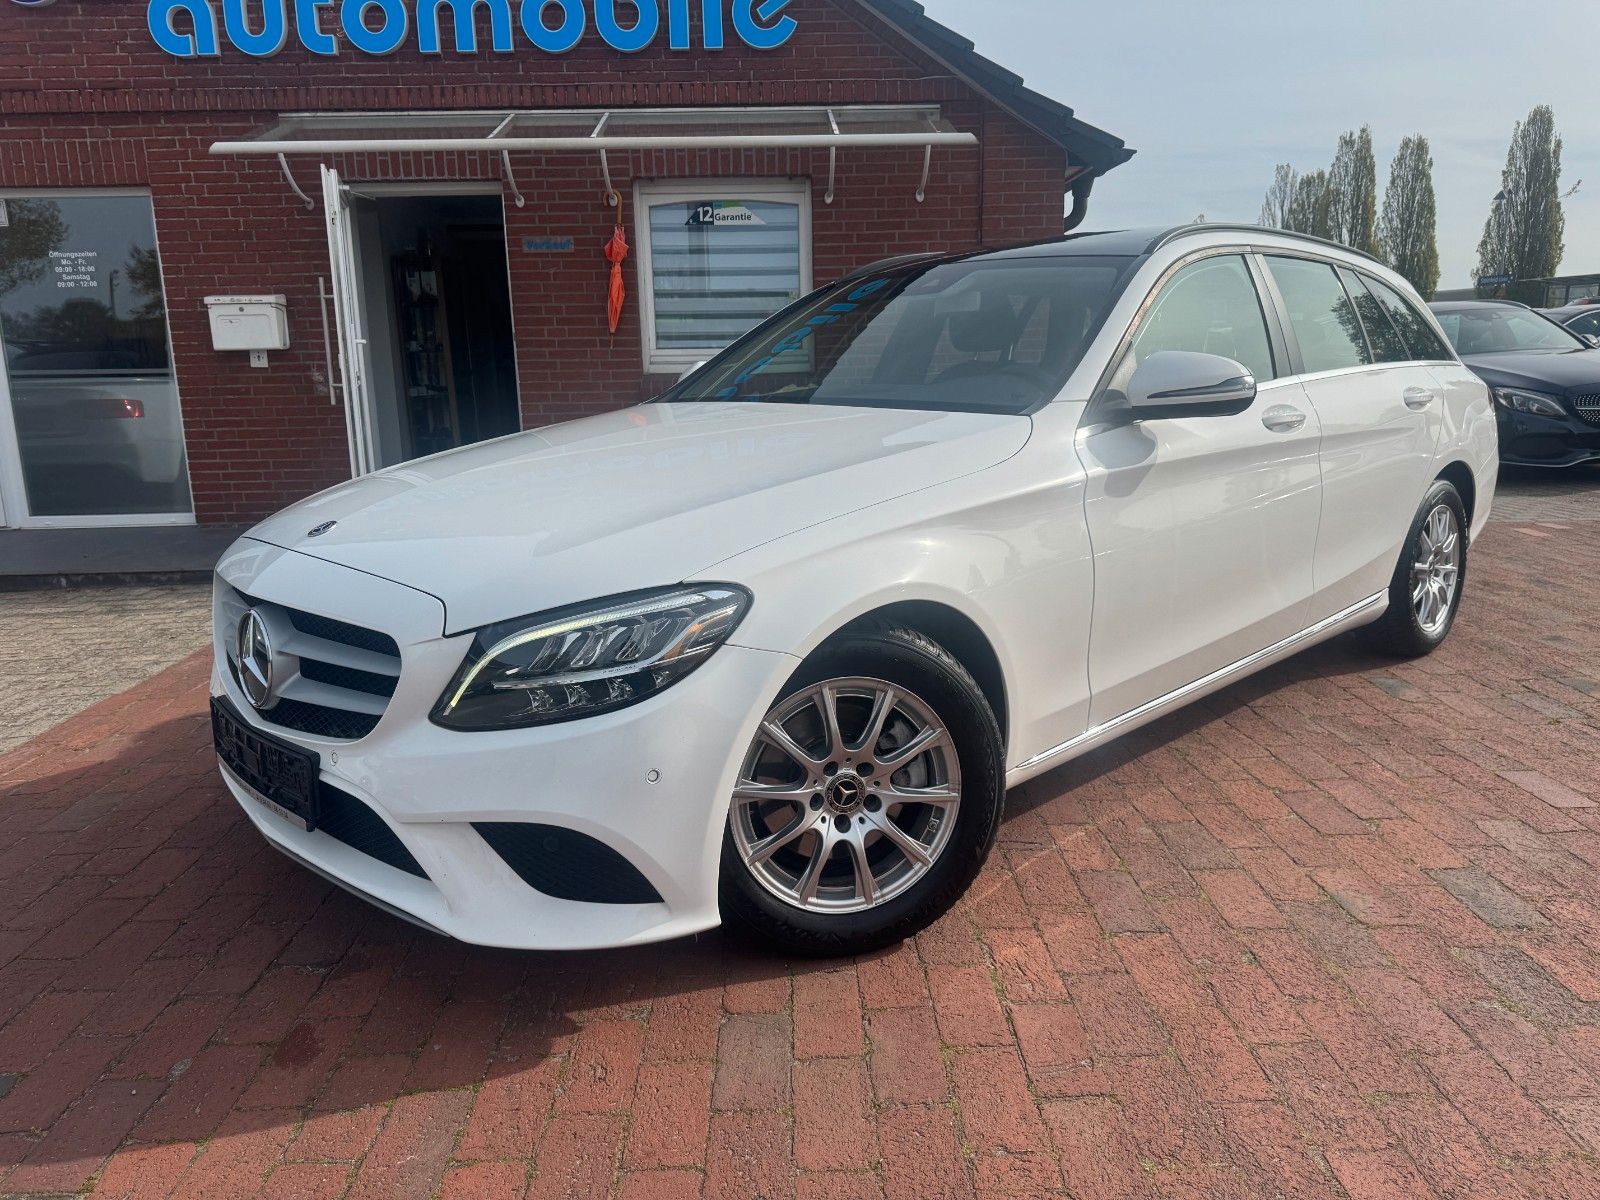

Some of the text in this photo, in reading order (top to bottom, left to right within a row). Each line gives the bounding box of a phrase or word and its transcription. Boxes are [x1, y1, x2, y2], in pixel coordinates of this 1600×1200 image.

[148, 0, 798, 57] automobile
[697, 206, 714, 222] 12
[714, 212, 752, 221] Garantie
